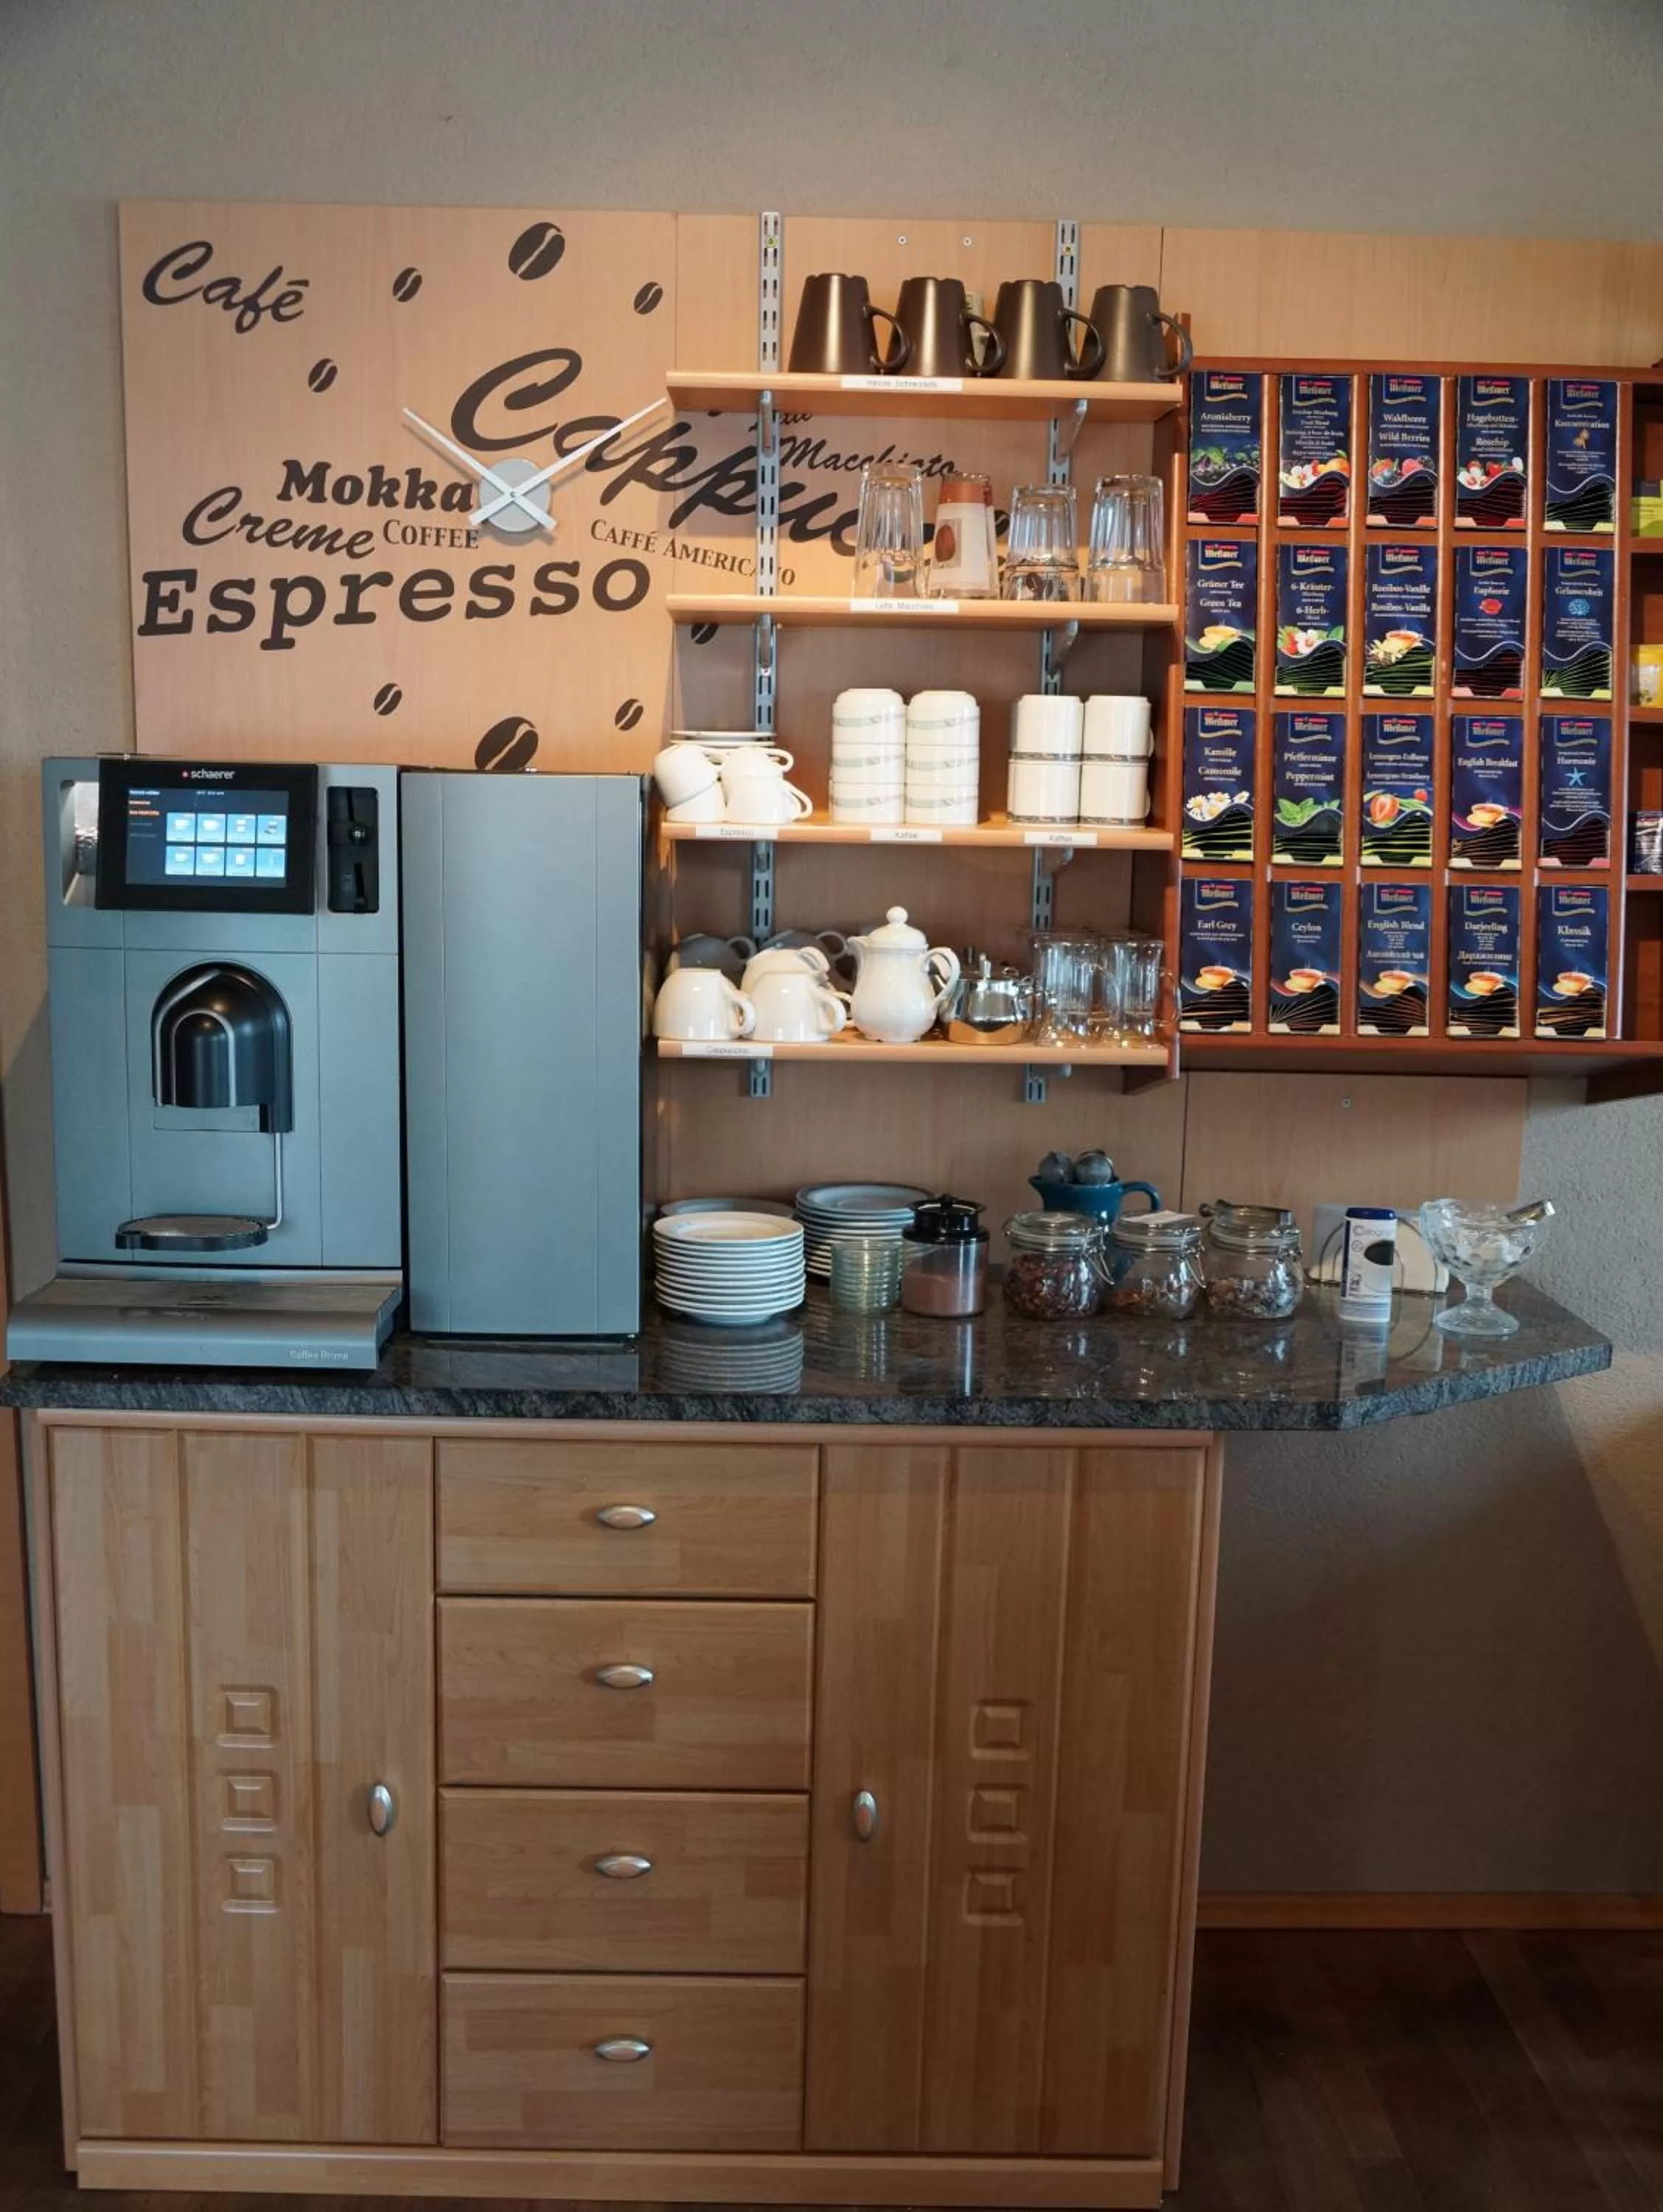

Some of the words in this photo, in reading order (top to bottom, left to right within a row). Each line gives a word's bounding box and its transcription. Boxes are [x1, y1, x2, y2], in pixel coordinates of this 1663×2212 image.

[142, 240, 310, 334] Café
[1379, 432, 1399, 441] Wild
[1401, 433, 1431, 442] Berries
[451, 348, 936, 557] Cappuc
[277, 459, 473, 512] Mokka
[182, 486, 375, 559] Creme
[383, 518, 479, 550] COFFEE
[663, 539, 796, 586] AMERICO
[136, 558, 651, 651] Espresso
[1199, 599, 1225, 608] Green
[1227, 599, 1242, 608] Tea
[1204, 747, 1237, 757] Kamille
[1457, 757, 1484, 768] English
[1485, 757, 1519, 768] Breakfast
[191, 769, 235, 779] schaerer
[1286, 771, 1334, 782] Peppermint
[1198, 920, 1215, 929] Earl
[1216, 920, 1237, 931] Grey
[1291, 922, 1322, 933] Ceylon
[1367, 920, 1398, 931] English
[1401, 921, 1424, 930] Blend
[1465, 922, 1507, 934] Darjeeling
[1558, 925, 1591, 936] Klassik
